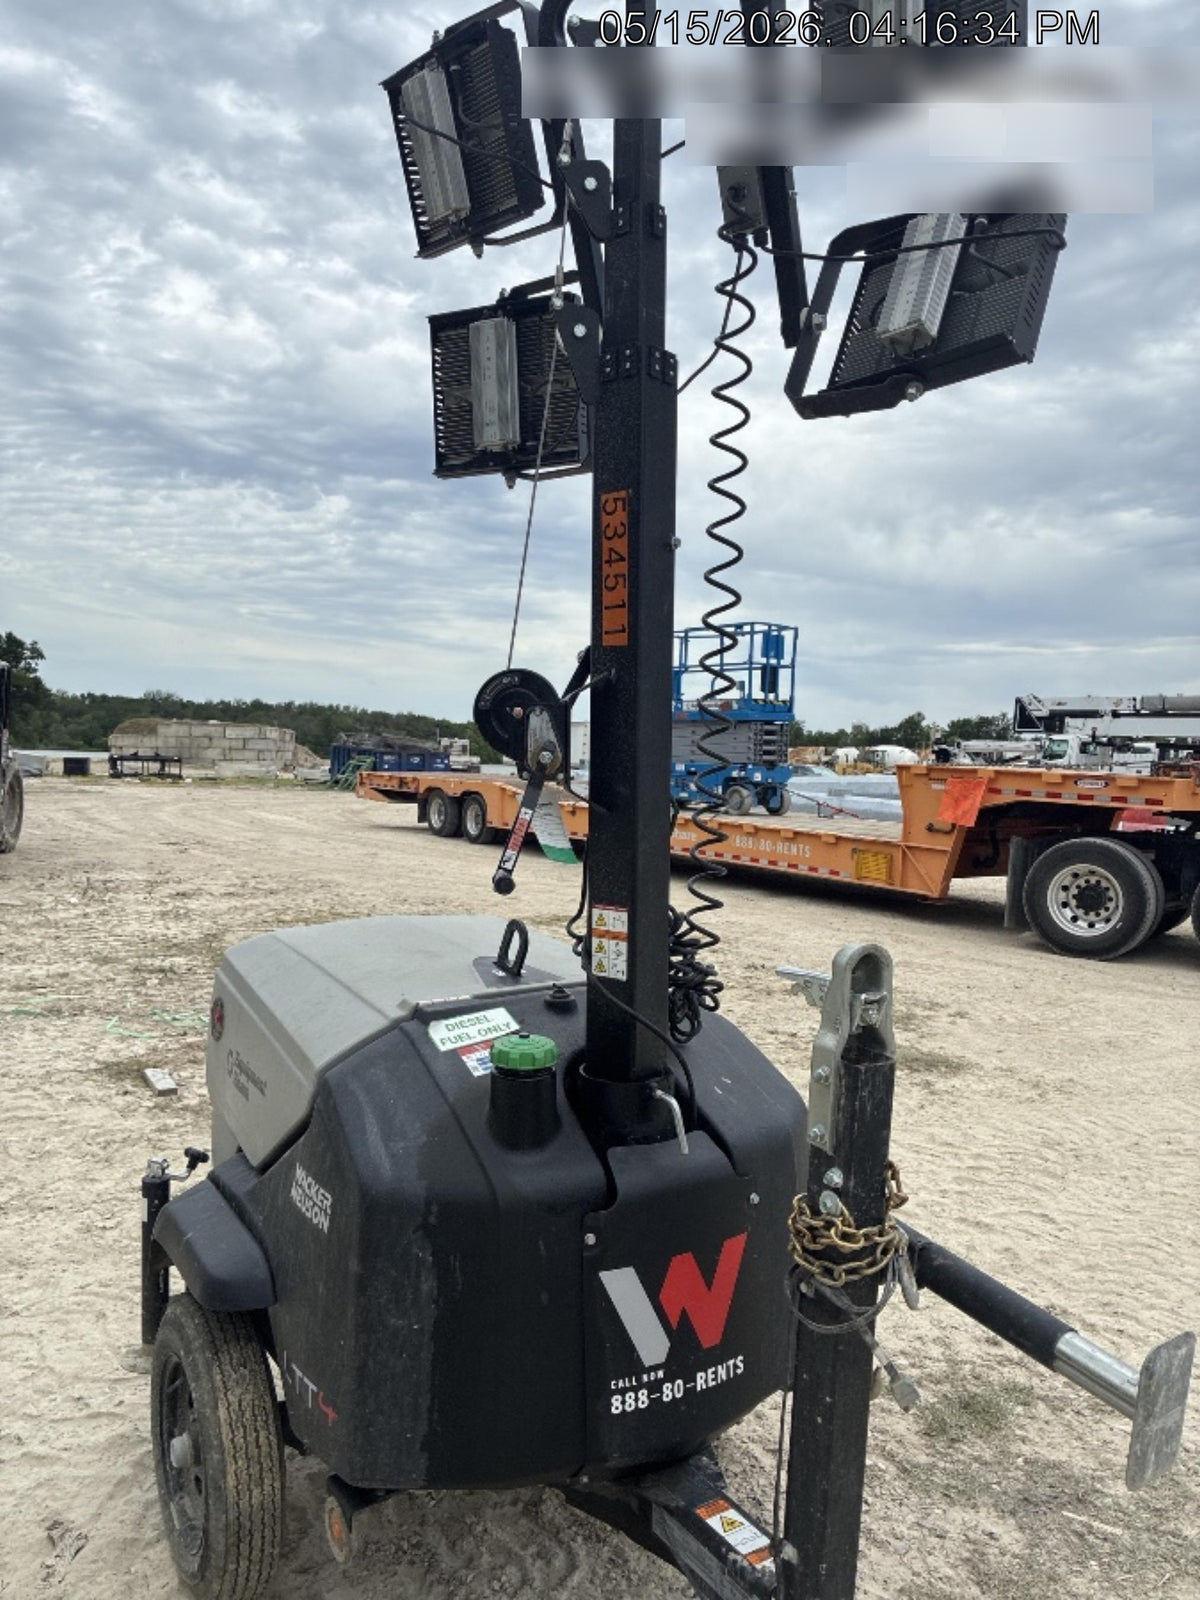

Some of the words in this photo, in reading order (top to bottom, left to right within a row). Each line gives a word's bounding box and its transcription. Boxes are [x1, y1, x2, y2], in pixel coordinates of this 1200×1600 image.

[601, 495, 628, 637] 534511
[759, 838, 813, 858] 80-RENTS
[439, 1029, 478, 1047] FUEL
[477, 1021, 512, 1038] ONLY
[444, 1012, 495, 1032] DIESEL
[290, 1180, 331, 1235] NEUSON
[295, 1161, 333, 1216] WACKER
[610, 1376, 638, 1390] CALL
[642, 1368, 666, 1384] NOW
[610, 1354, 745, 1415] 888-80-RENTS
